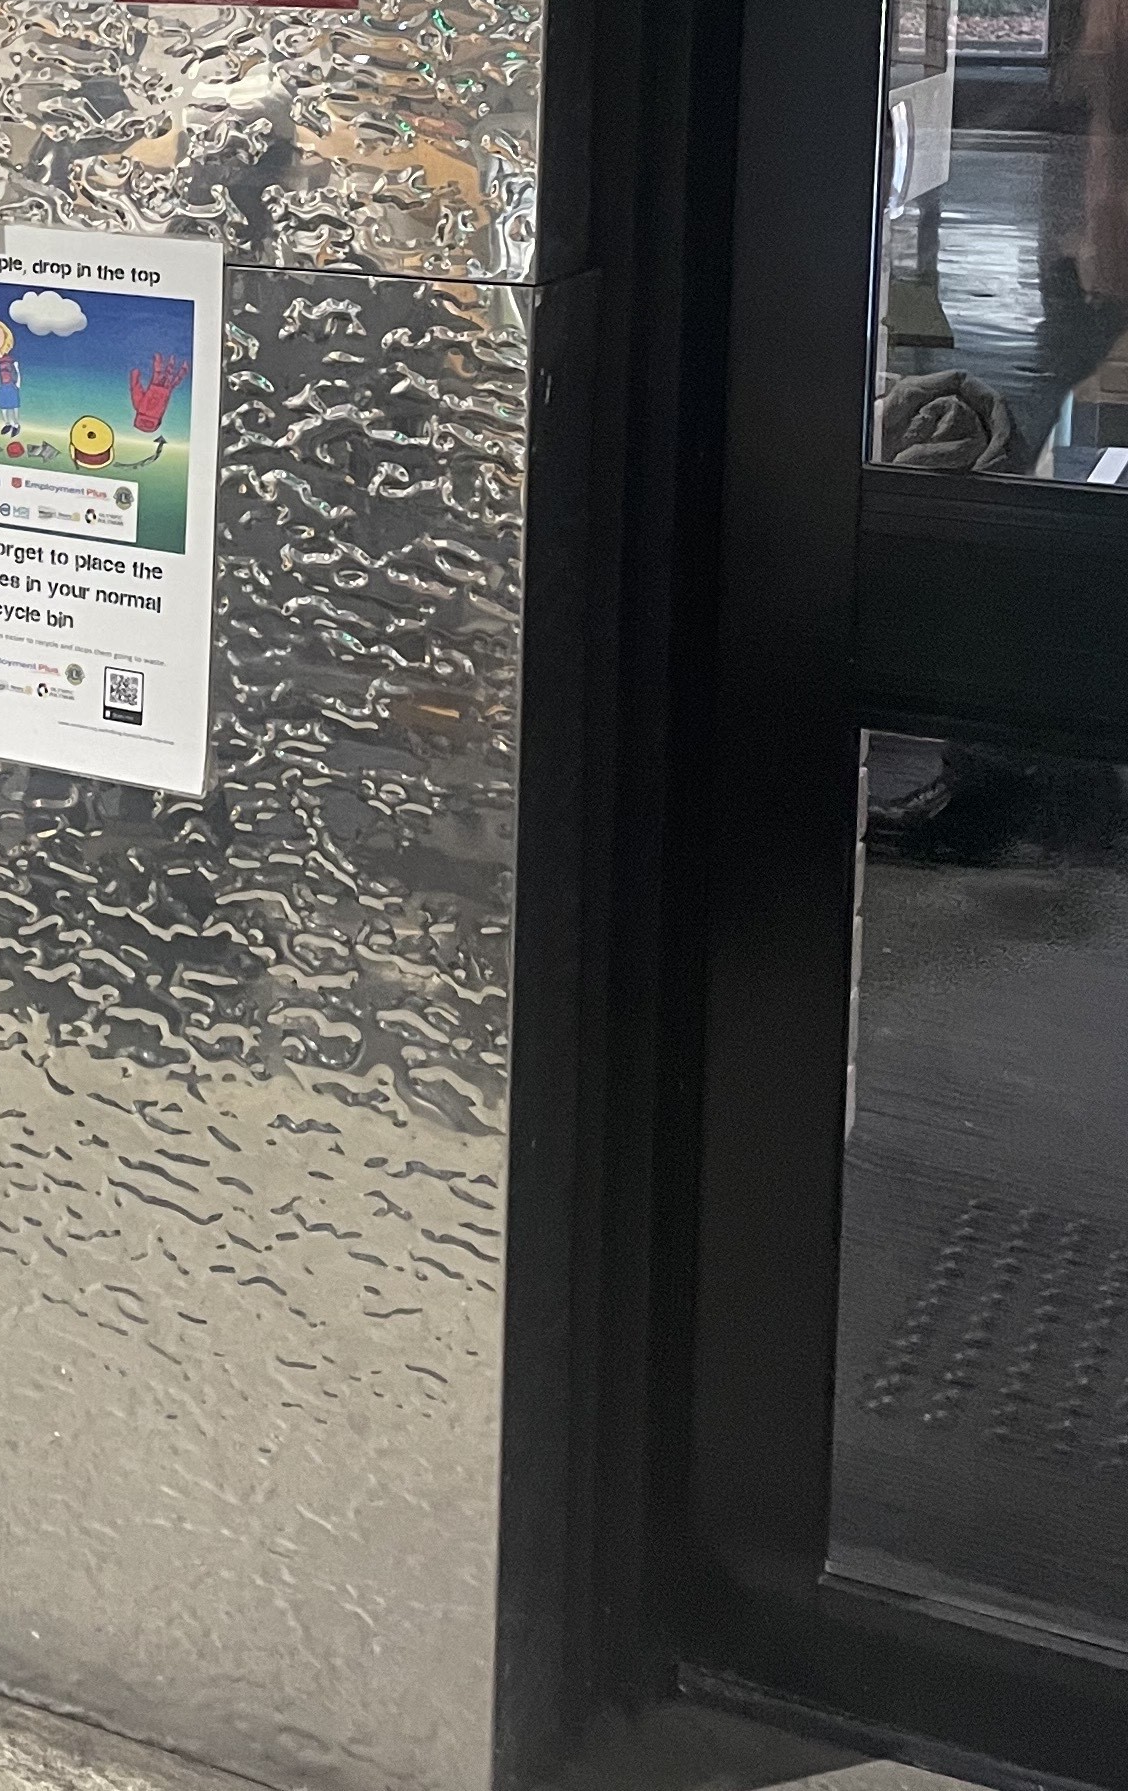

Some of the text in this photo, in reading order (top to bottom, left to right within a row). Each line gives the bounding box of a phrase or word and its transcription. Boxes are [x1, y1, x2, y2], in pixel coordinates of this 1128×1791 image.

[32, 258, 72, 279] drop
[76, 261, 92, 280] in
[97, 264, 125, 282] the
[130, 267, 161, 286] top
[24, 479, 85, 496] Employment
[49, 548, 69, 566] to
[75, 552, 126, 575] place
[132, 561, 163, 580] the
[26, 575, 41, 593] in
[47, 579, 90, 601] your
[95, 588, 162, 614] normal
[46, 609, 74, 629] bin
